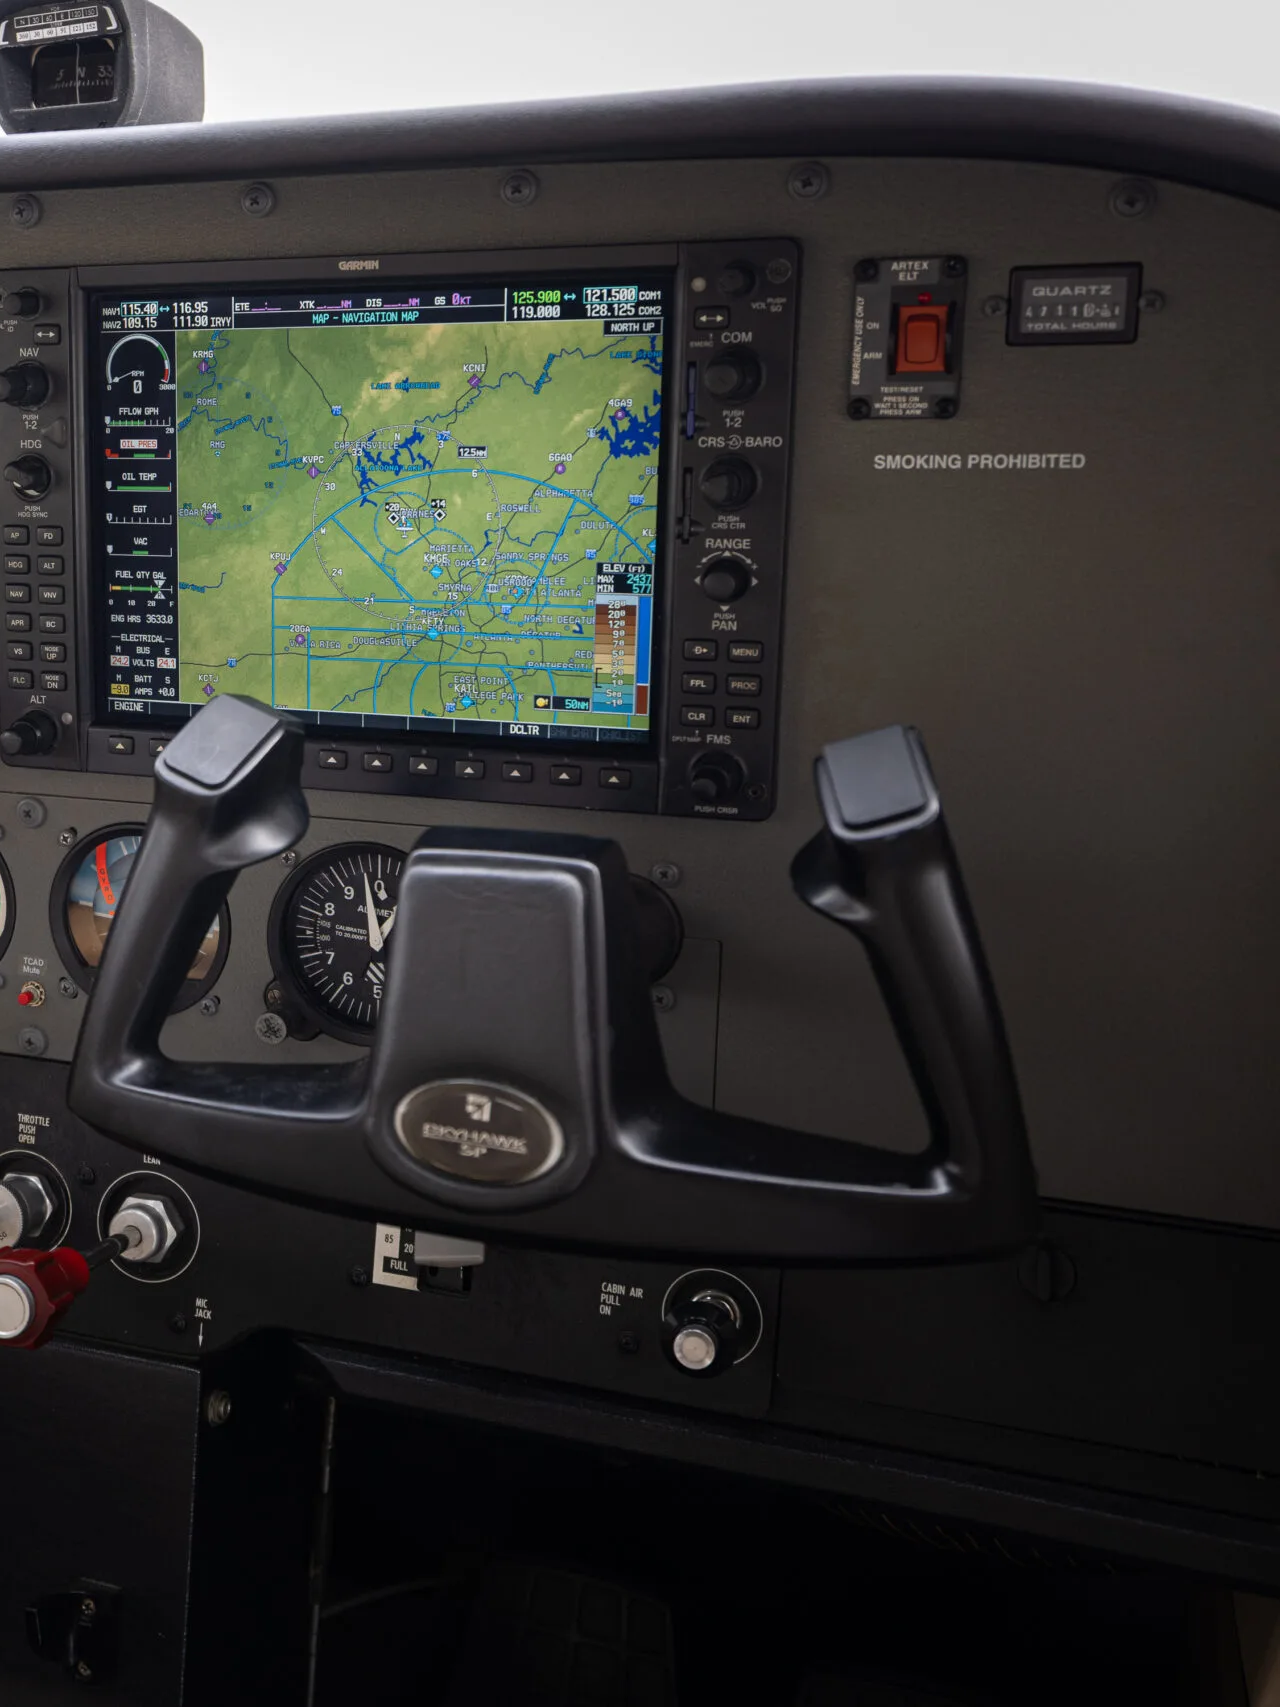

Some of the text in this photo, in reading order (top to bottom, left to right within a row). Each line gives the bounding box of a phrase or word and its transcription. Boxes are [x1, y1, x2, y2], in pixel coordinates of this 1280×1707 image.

[98, 66, 114, 76] 33
[339, 260, 379, 271] GARMIN
[892, 262, 929, 270] ARTEX
[899, 272, 919, 281] ELT
[512, 288, 661, 304] 125.900 121.500 COM1
[1032, 285, 1111, 296] QUARTZ
[173, 302, 208, 314] 116.95
[300, 300, 315, 310] XTK
[366, 299, 382, 308] DIS
[103, 304, 157, 316] NAV1 115.40
[512, 304, 662, 318] 119.000 128.125 COM2
[103, 317, 157, 329] NAV2 109.15
[173, 316, 231, 327] 111.90 IRYY
[312, 311, 419, 324] MAP NAVIGATION MAP
[611, 323, 655, 332] NORTH UP
[1072, 322, 1117, 330] HOURS
[721, 332, 752, 343] COM
[20, 348, 39, 356] NAV
[725, 418, 742, 428] 1-2
[20, 440, 42, 448] HDG
[138, 440, 157, 448] PRES
[698, 436, 783, 448] CRS BARO
[302, 455, 324, 465] KVPC
[874, 453, 1085, 470] SMOKING PROHIBITED
[501, 504, 541, 513] ROSWELL
[705, 538, 751, 549] RANGE
[116, 571, 133, 579] FUEL
[136, 571, 150, 579] QTY
[597, 574, 652, 584] MAX 2437
[597, 584, 652, 593] MIN 577
[712, 620, 737, 631] PAN
[121, 634, 165, 643] ELECTRICAL
[732, 648, 758, 657] MENU
[731, 681, 757, 690] PROC
[30, 696, 46, 704] ALT
[114, 702, 143, 711] ENGINE
[688, 712, 705, 720] CLR
[733, 715, 750, 724] ENT
[510, 725, 539, 736] DCLTR
[706, 735, 731, 744] FMS
[344, 886, 354, 900] 9
[324, 902, 335, 916] 8
[23, 957, 44, 967] TCAD
[325, 952, 335, 965] 7
[23, 966, 40, 975] Mute
[343, 972, 353, 985] 6
[373, 985, 382, 999] 5
[18, 1113, 50, 1127] THROTTLE
[19, 1124, 36, 1135] PUSH
[18, 1134, 35, 1145] OPEN
[384, 1234, 394, 1244] 85
[390, 1260, 408, 1272] FULL
[601, 1282, 644, 1298] CABIN AIR
[195, 1297, 208, 1309] MIC
[600, 1293, 621, 1306] PULL
[194, 1307, 211, 1320] JACK
[600, 1304, 611, 1315] ON
